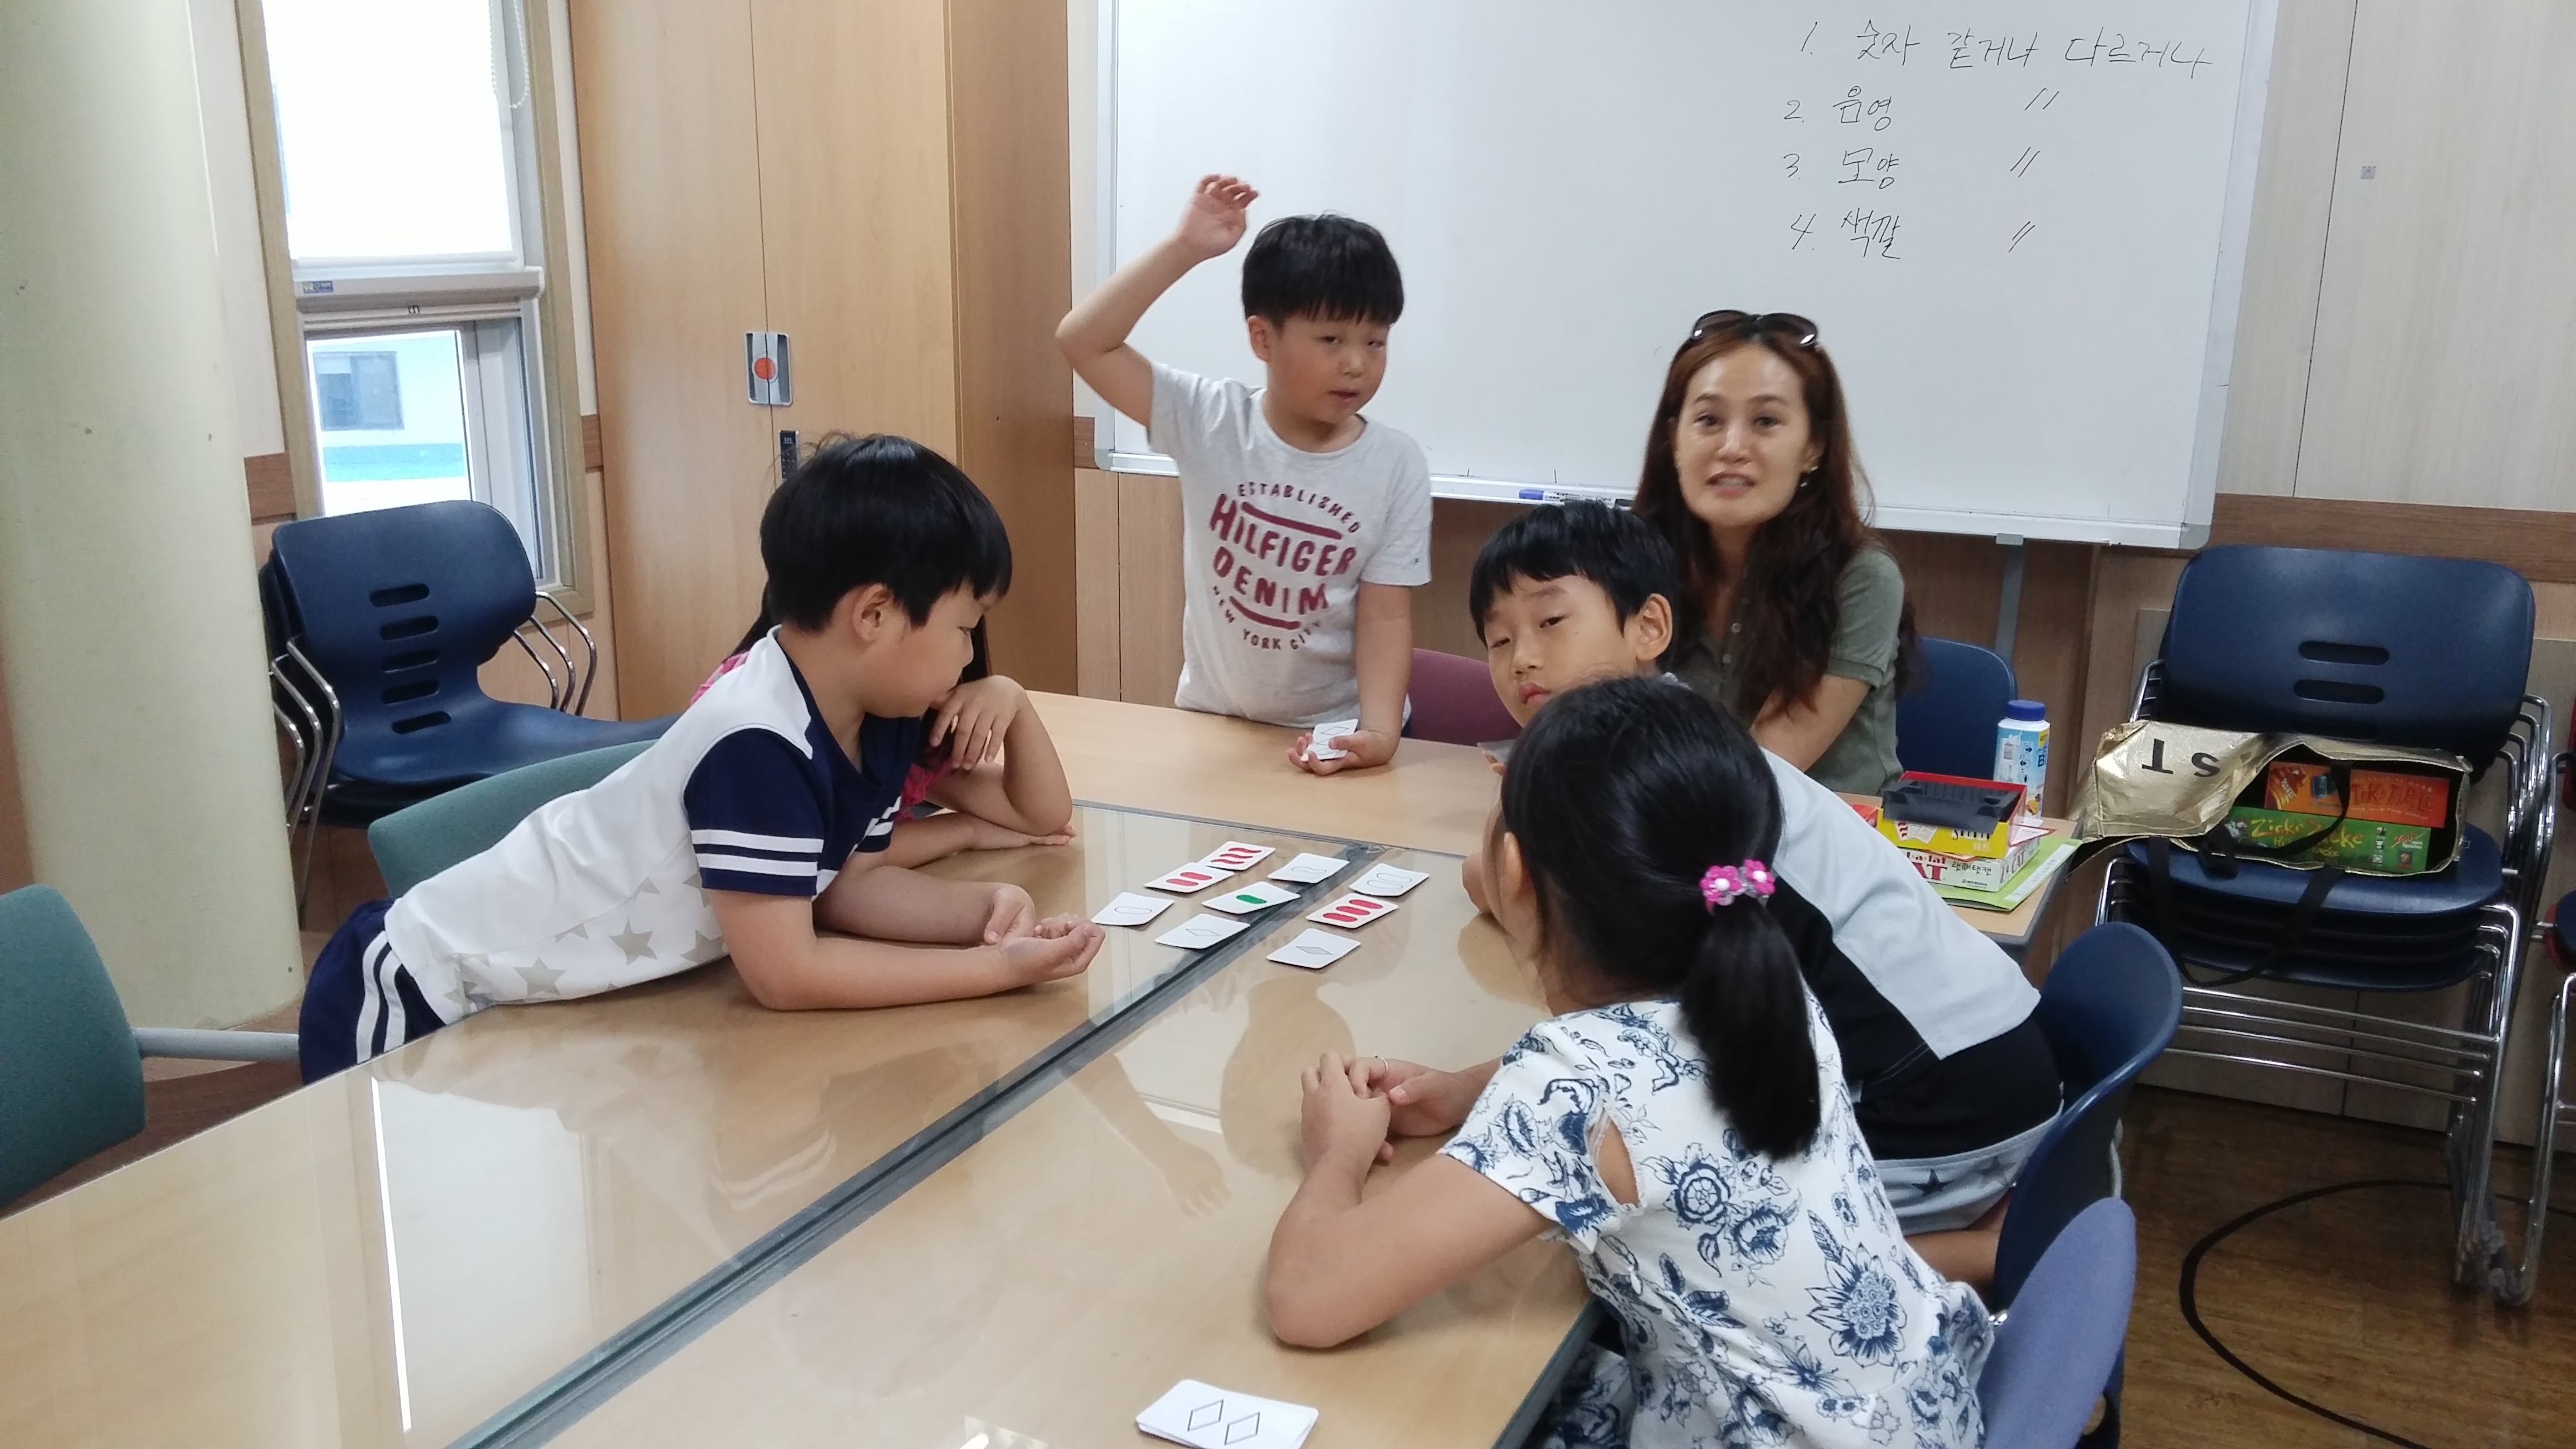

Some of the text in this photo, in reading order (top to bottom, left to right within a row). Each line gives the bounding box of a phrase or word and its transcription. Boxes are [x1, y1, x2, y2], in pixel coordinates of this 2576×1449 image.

[1856, 19, 1920, 65] 숫자
[1947, 28, 2039, 69] 같거나
[2065, 27, 2213, 79] 다르거나
[1833, 85, 1892, 131] 음영
[1838, 147, 1899, 189] 모양
[1841, 207, 1900, 259] 색깔
[1238, 481, 1361, 533] ESTABLISHED
[1209, 494, 1357, 576] HILFIGER
[1213, 546, 1329, 615] DENIM
[1243, 629, 1281, 650] YORK
[2250, 818, 2304, 837] Zicke
